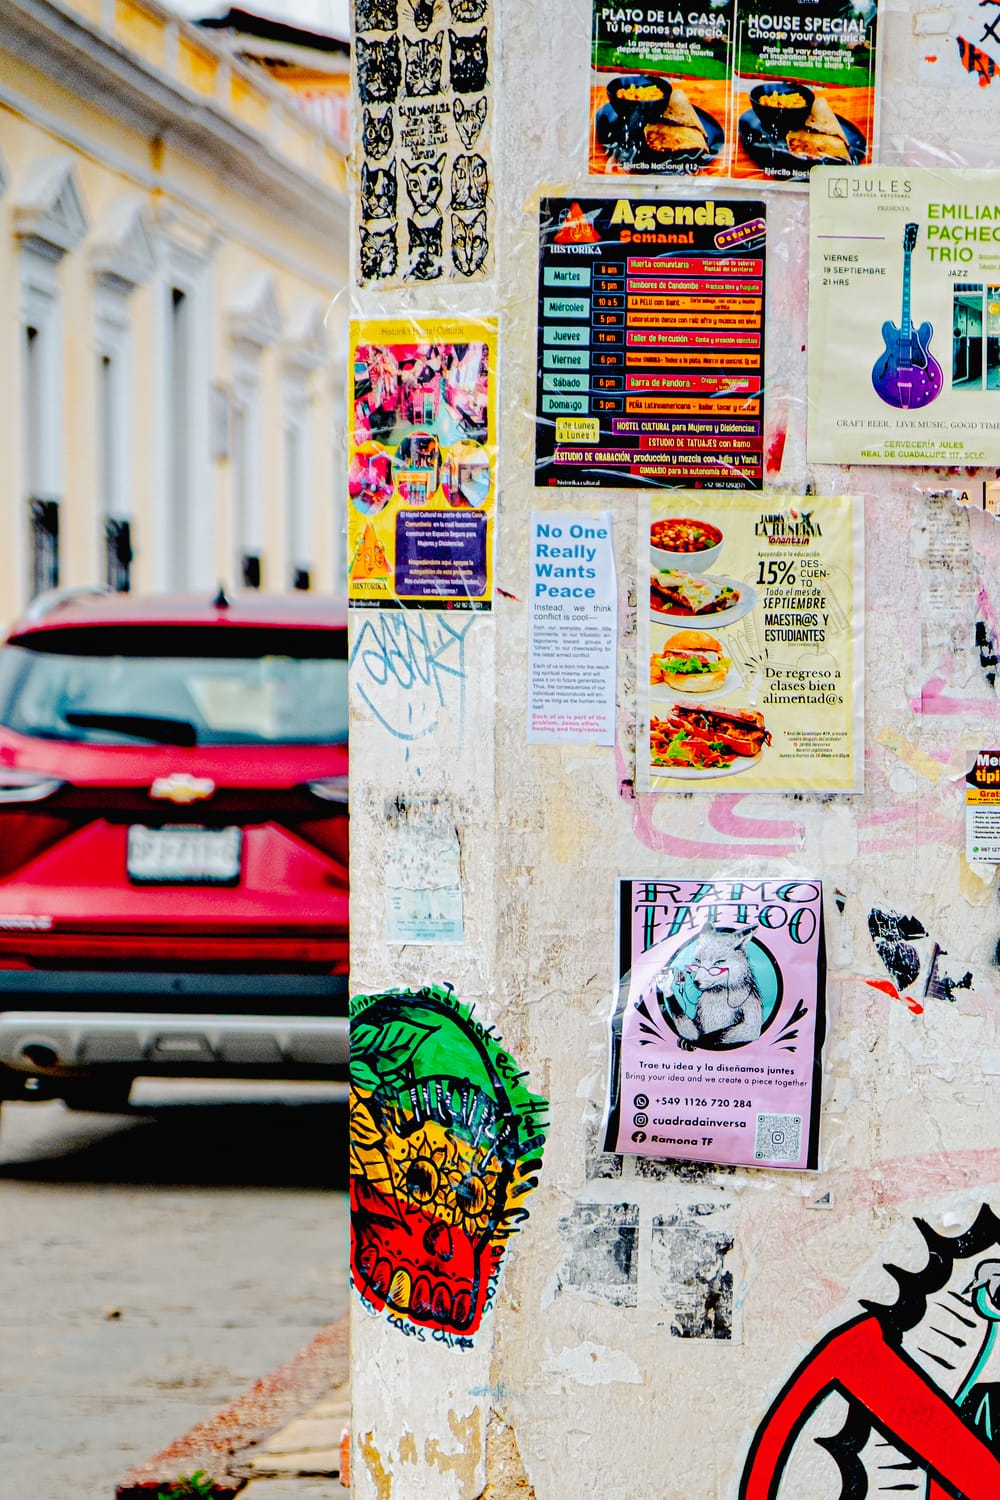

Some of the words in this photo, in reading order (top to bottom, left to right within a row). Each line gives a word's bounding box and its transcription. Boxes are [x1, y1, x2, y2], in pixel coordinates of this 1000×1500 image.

[602, 8, 643, 22] PLATO
[647, 10, 664, 23] DE
[668, 11, 684, 24] LA
[688, 12, 726, 26] CASA
[748, 14, 800, 31] HOUSE
[804, 17, 866, 33] SPECIAL
[606, 21, 618, 32] Tú
[621, 22, 632, 32] le
[635, 24, 670, 35] pones
[672, 26, 683, 36] el
[686, 27, 723, 38] precio
[748, 29, 788, 39] Choose
[790, 32, 813, 42] your
[816, 33, 837, 41] own
[840, 34, 866, 43] price
[852, 179, 912, 192] JULES
[610, 199, 735, 231] Agenda
[619, 229, 695, 245] Semanal
[550, 245, 602, 255] HISTORIKA
[927, 241, 973, 262] TRÍO
[824, 254, 859, 262] VIERNES
[553, 270, 581, 281] Martes
[824, 266, 831, 274] 19
[833, 266, 886, 275] SEPTIEMBRE
[549, 302, 585, 313] Miércoles
[553, 331, 580, 341] Jueves
[552, 354, 581, 365] Viernes
[553, 377, 581, 388] Sábado
[649, 438, 675, 447] ESTUDIO
[677, 439, 685, 447] DE
[687, 439, 717, 448] TATUAJES
[719, 440, 731, 448] con
[733, 439, 751, 448] Ramo
[536, 524, 562, 538] No
[569, 524, 608, 539] One
[536, 543, 597, 562] Really
[535, 563, 596, 578] Wants
[800, 560, 823, 568] DES-
[756, 560, 796, 585] 15%
[800, 569, 830, 577] CUEN-
[535, 583, 596, 598] Peace
[534, 603, 564, 612] Instead,
[763, 597, 826, 609] SEPTIEMBRE
[765, 613, 818, 627] MAESTR@S
[822, 614, 829, 627] Y
[765, 629, 825, 642] ESTUDIANTES
[765, 667, 783, 678] De
[786, 670, 831, 681] regreso
[770, 680, 806, 691] clases
[808, 680, 836, 691] bien
[762, 693, 844, 705] alimentad@s
[636, 882, 819, 904] RAMO
[635, 903, 817, 954] TATTOO
[639, 1061, 659, 1070] Trae
[661, 1063, 671, 1071] tu
[673, 1062, 694, 1071] idea
[704, 1063, 714, 1071] la
[716, 1062, 764, 1074] diseñamos
[767, 1065, 795, 1076] juntes
[655, 1097, 680, 1106] +549
[684, 1098, 707, 1107] 1126
[711, 1099, 730, 1108] 720
[733, 1099, 752, 1108] 284
[652, 1116, 747, 1128] cuadradainversa
[651, 1135, 698, 1146] Ramona
[702, 1138, 714, 1146] TF
